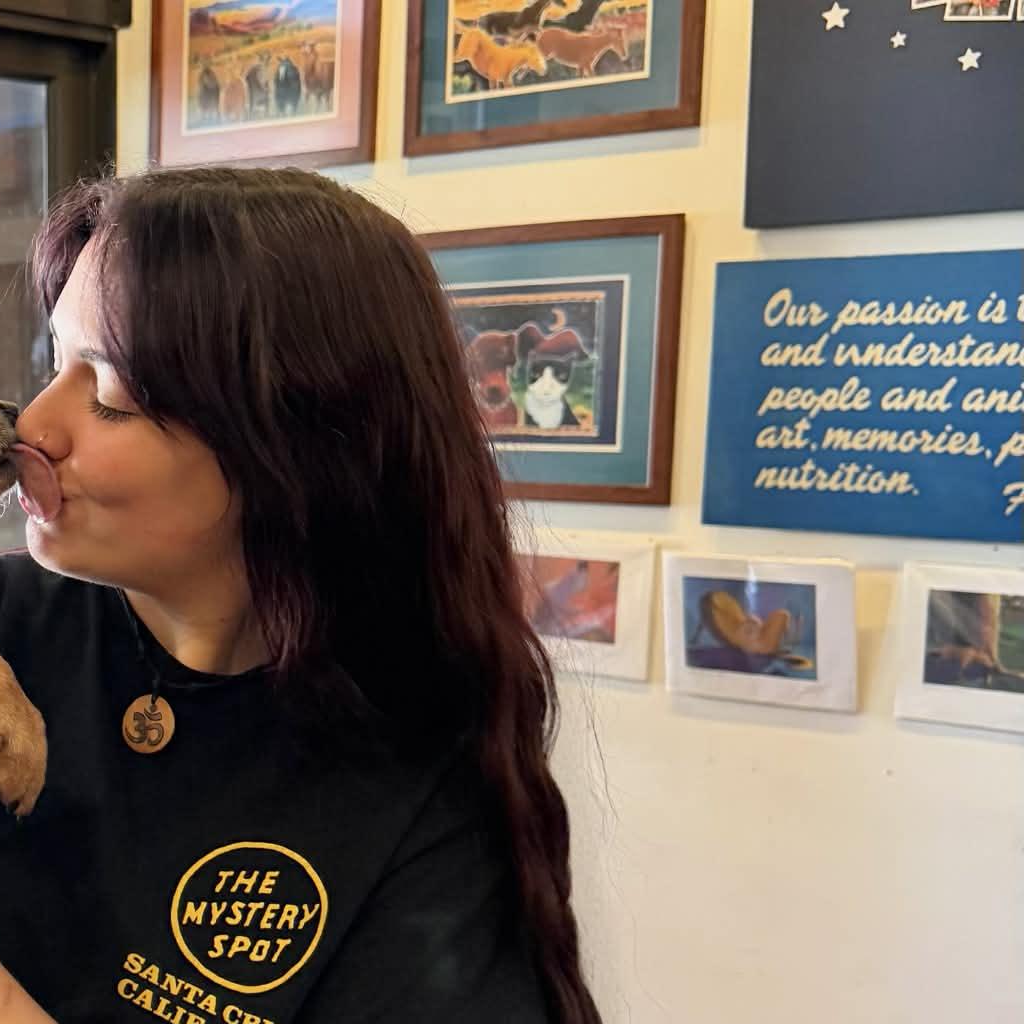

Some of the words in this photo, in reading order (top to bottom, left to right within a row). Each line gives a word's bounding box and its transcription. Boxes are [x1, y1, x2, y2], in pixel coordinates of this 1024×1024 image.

[763, 287, 829, 328] Our
[831, 296, 971, 335] passion
[977, 291, 1008, 324] is
[761, 332, 830, 367] and
[757, 376, 872, 419] people
[880, 376, 958, 412] and
[754, 458, 920, 497] nutrition.
[214, 870, 280, 895] THE
[182, 900, 320, 930] MYSTERY
[207, 933, 292, 963] SPOT
[123, 952, 218, 1016] SANTA
